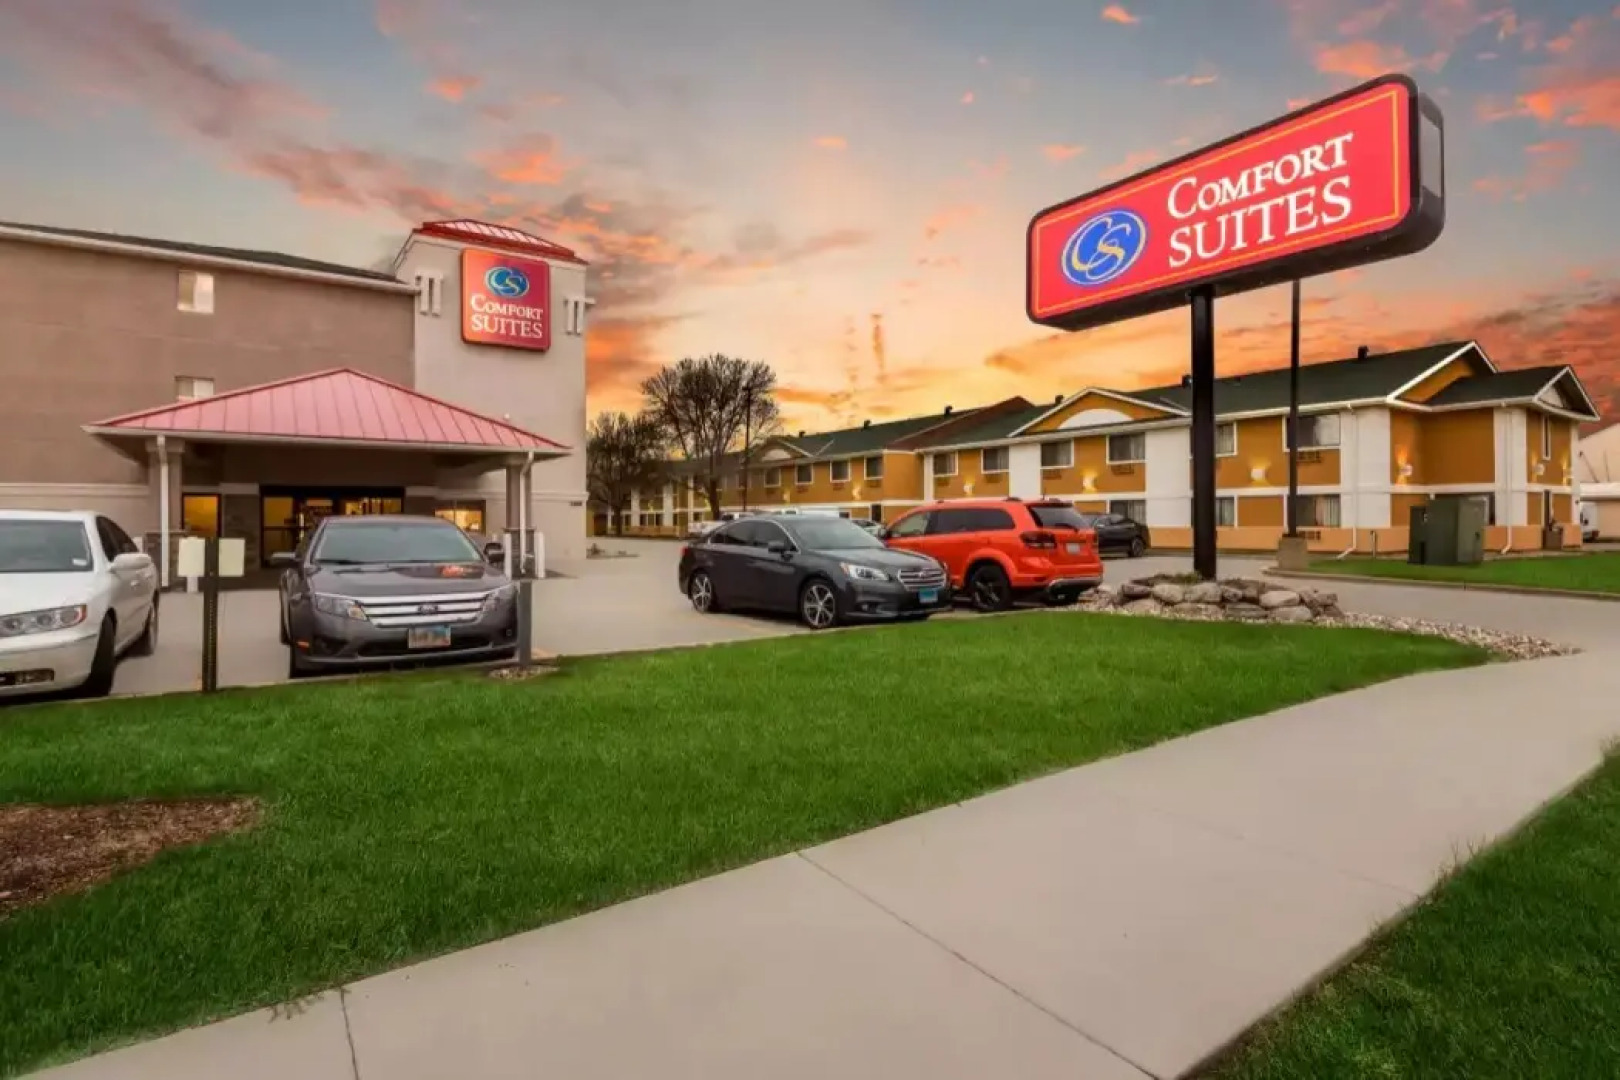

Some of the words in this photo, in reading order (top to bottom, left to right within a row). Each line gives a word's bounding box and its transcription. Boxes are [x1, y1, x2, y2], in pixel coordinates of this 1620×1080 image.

[1167, 133, 1353, 219] COMFORT
[1168, 177, 1352, 267] SUITES
[471, 294, 543, 320] COMFORT
[471, 313, 542, 338] SUITES
